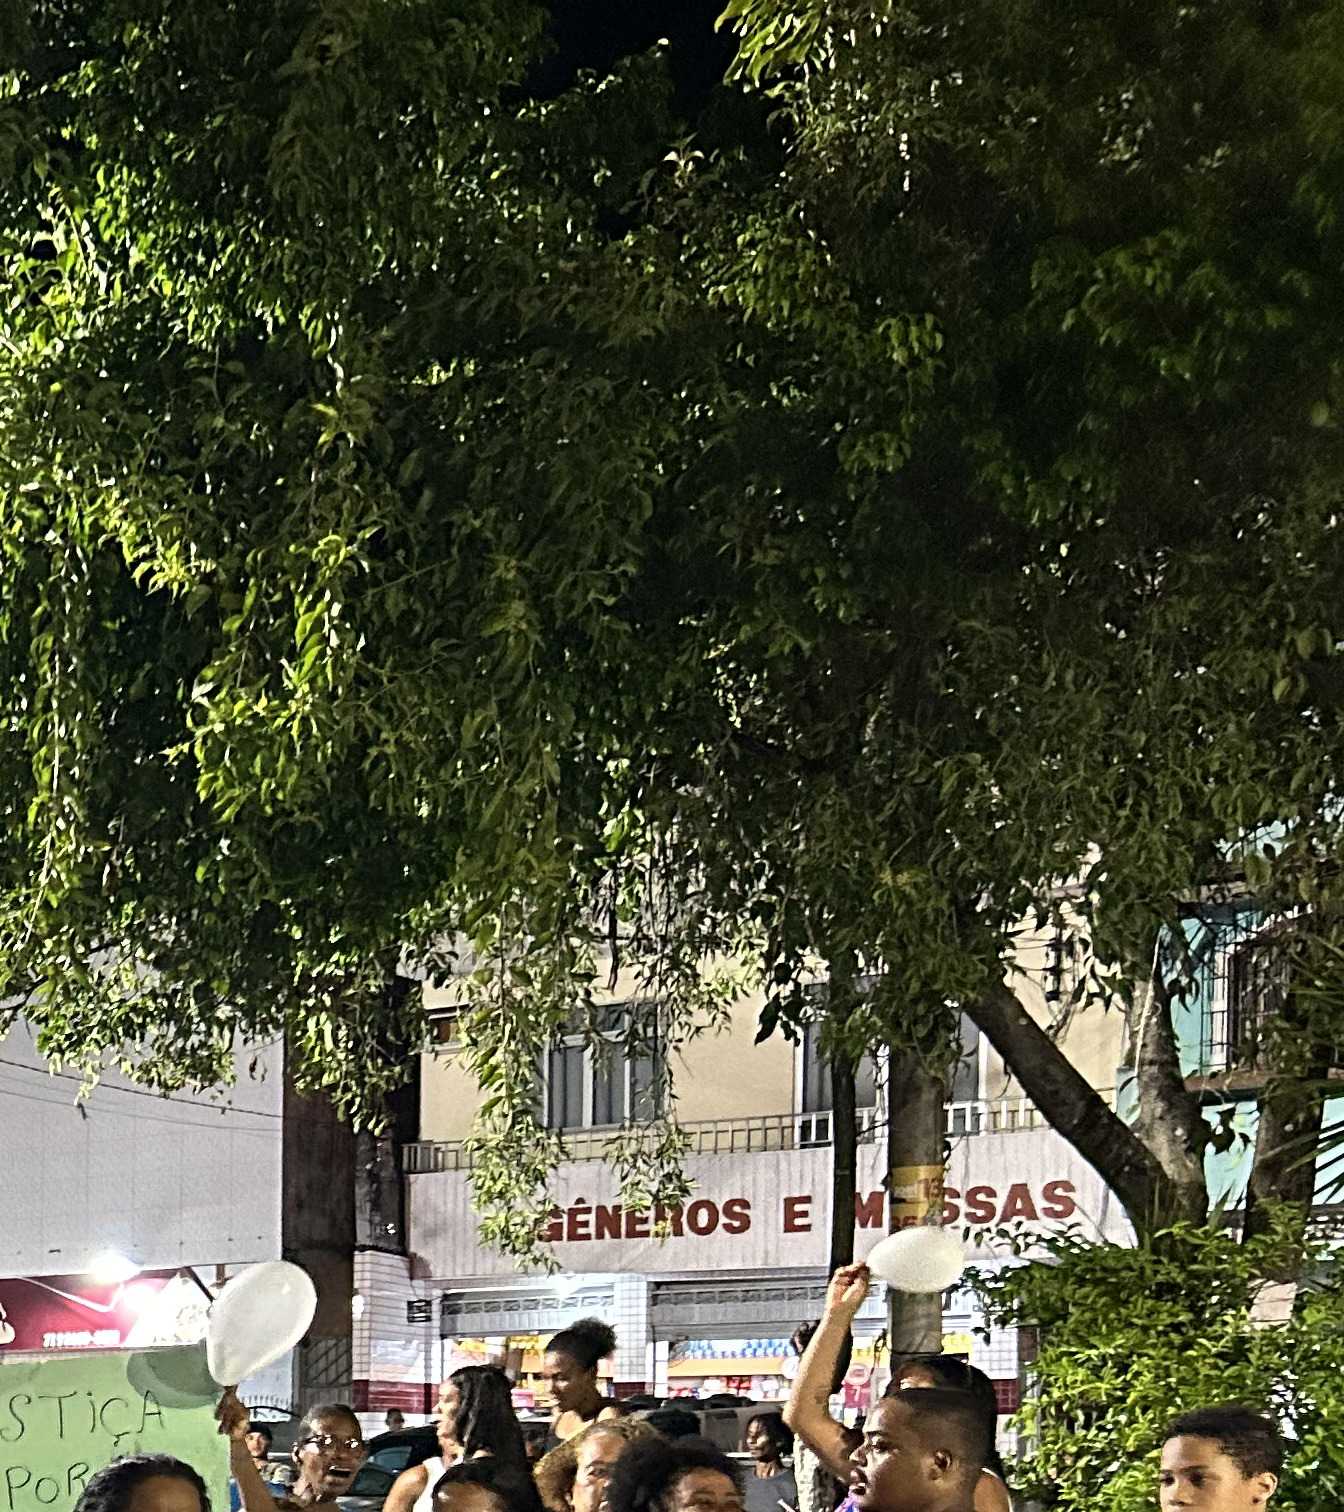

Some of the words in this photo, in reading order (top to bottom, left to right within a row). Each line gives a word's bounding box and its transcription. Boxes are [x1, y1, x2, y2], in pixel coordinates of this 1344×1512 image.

[534, 1197, 752, 1243] GÊNEROS
[784, 1196, 812, 1233] E
[854, 1180, 1076, 1229] MSSAS
[5, 1461, 89, 1511] POR
